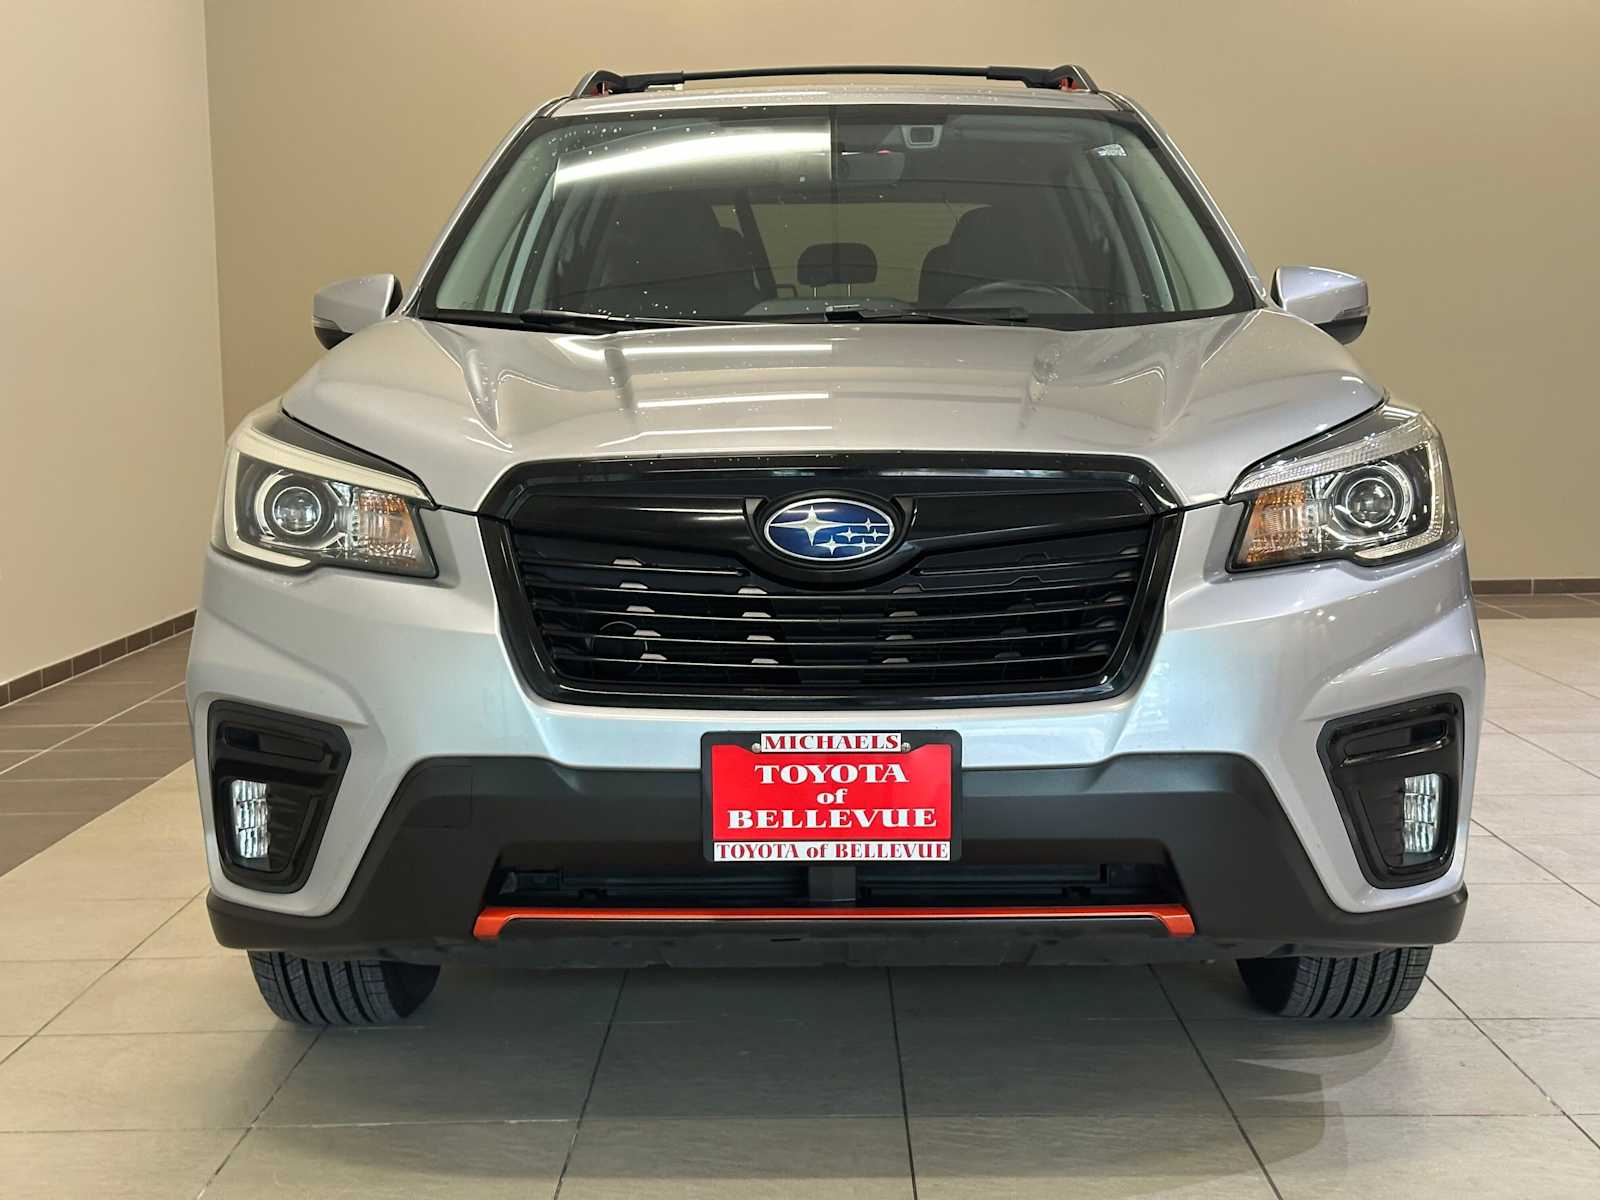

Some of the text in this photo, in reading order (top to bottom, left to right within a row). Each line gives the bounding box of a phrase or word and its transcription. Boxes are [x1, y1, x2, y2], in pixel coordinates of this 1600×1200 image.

[764, 735, 899, 750] MICHAELS
[754, 763, 910, 784] TOYOTA
[816, 788, 848, 805] of
[727, 807, 937, 829] BELLEVUE
[716, 842, 949, 859] TOYOTA of BELLEVUE
